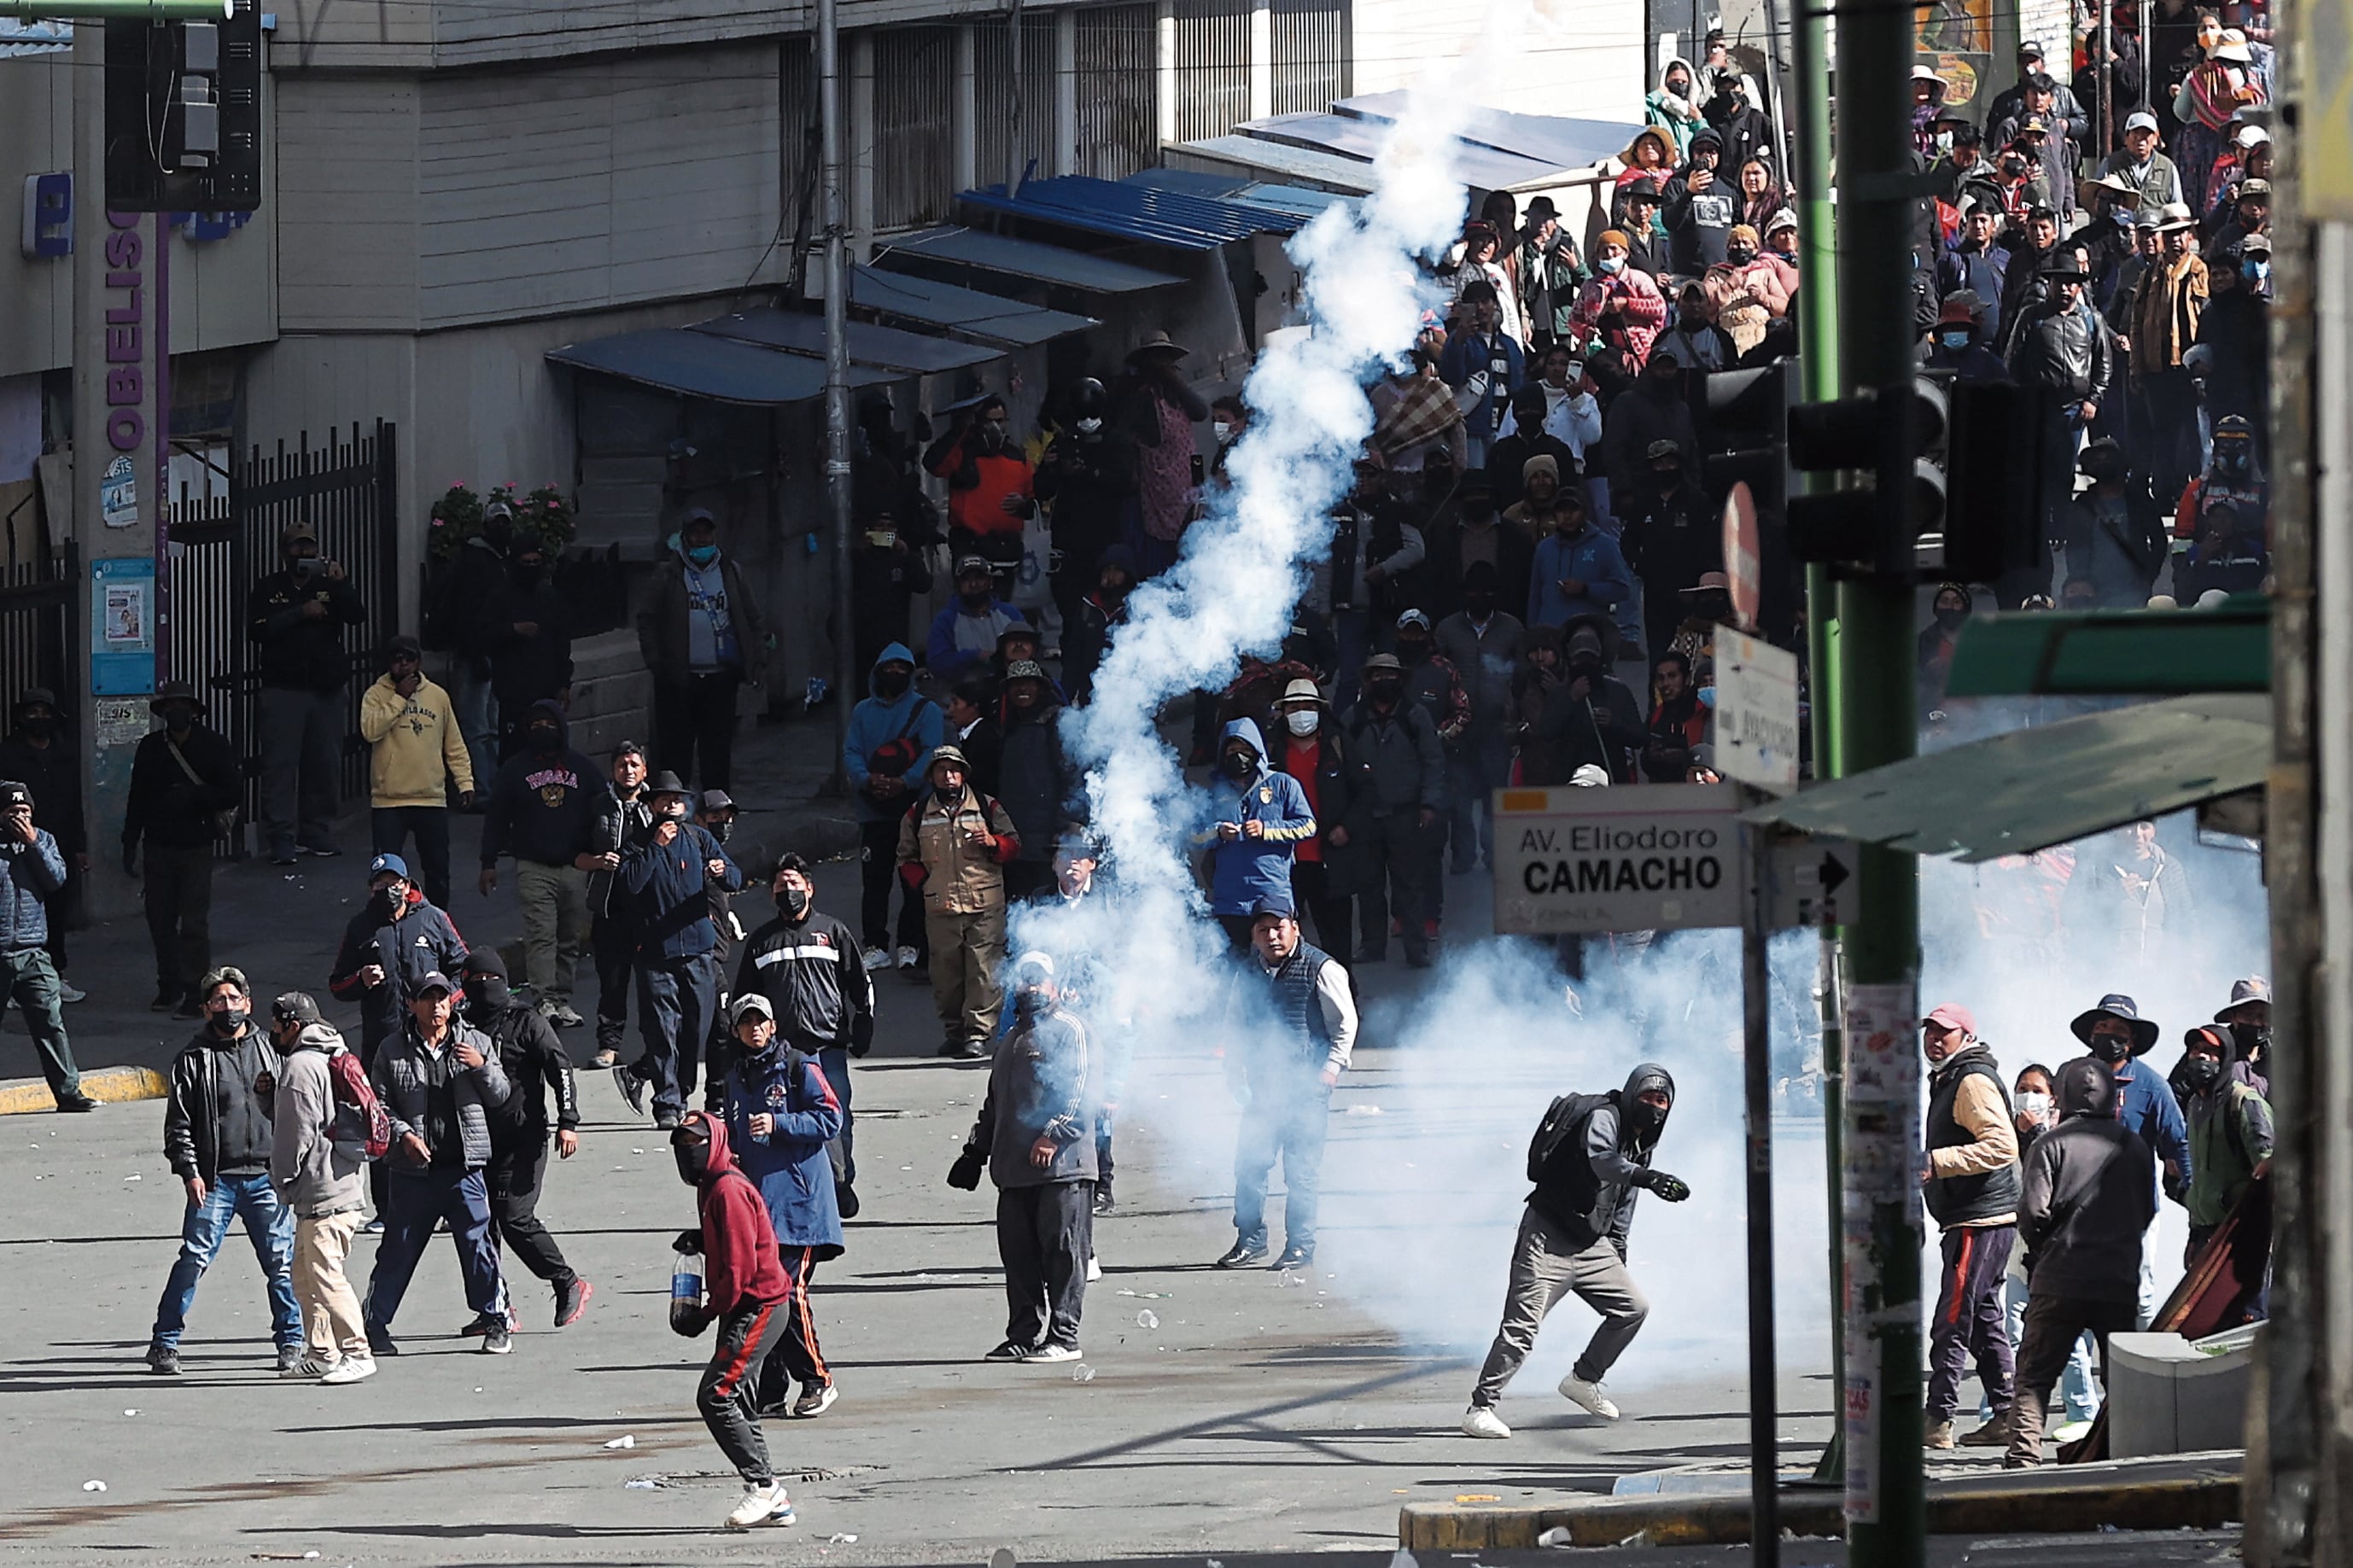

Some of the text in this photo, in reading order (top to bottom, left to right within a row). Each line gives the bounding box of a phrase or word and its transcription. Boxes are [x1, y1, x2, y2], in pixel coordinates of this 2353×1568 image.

[1521, 825, 1718, 853] AV. Eliodoro
[1523, 855, 1722, 895] CAMACHO
